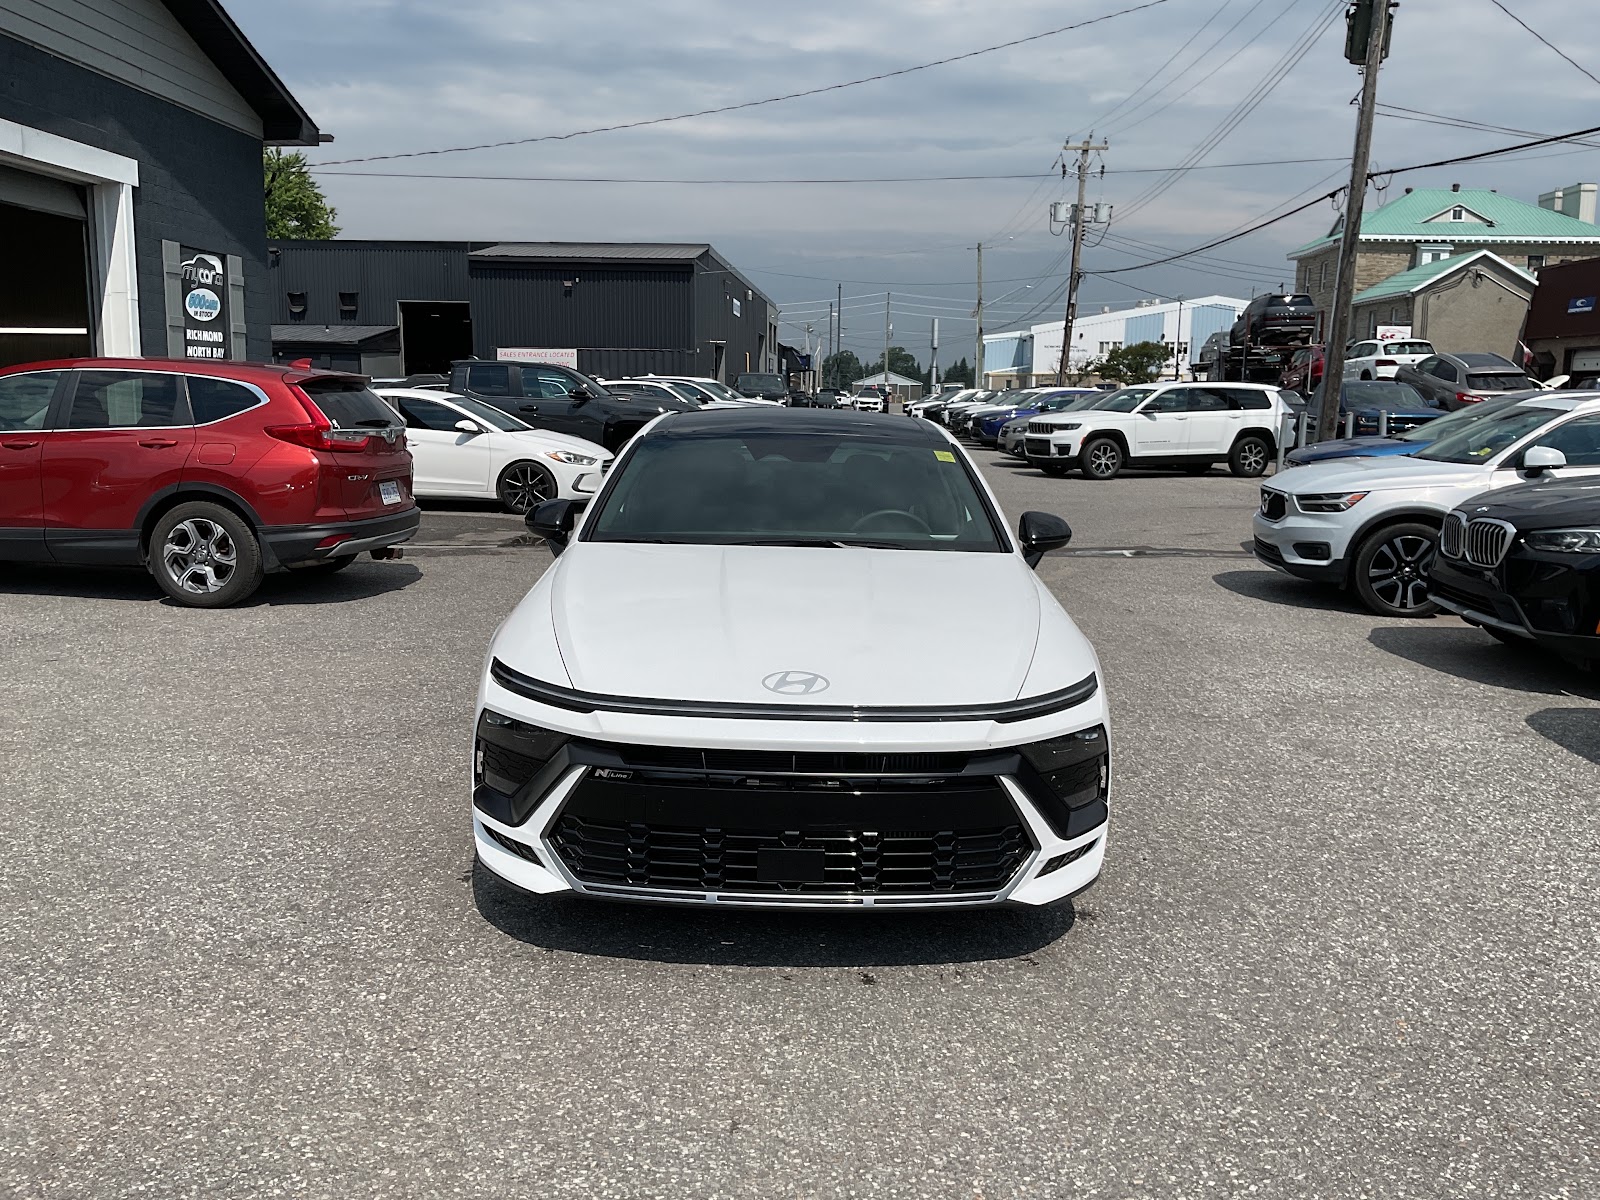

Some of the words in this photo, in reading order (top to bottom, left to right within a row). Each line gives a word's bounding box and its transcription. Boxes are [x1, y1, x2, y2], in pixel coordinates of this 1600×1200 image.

[186, 329, 223, 343] RICHMOND
[187, 345, 212, 358] NORTH
[212, 347, 225, 359] BAY
[595, 769, 609, 777] N
